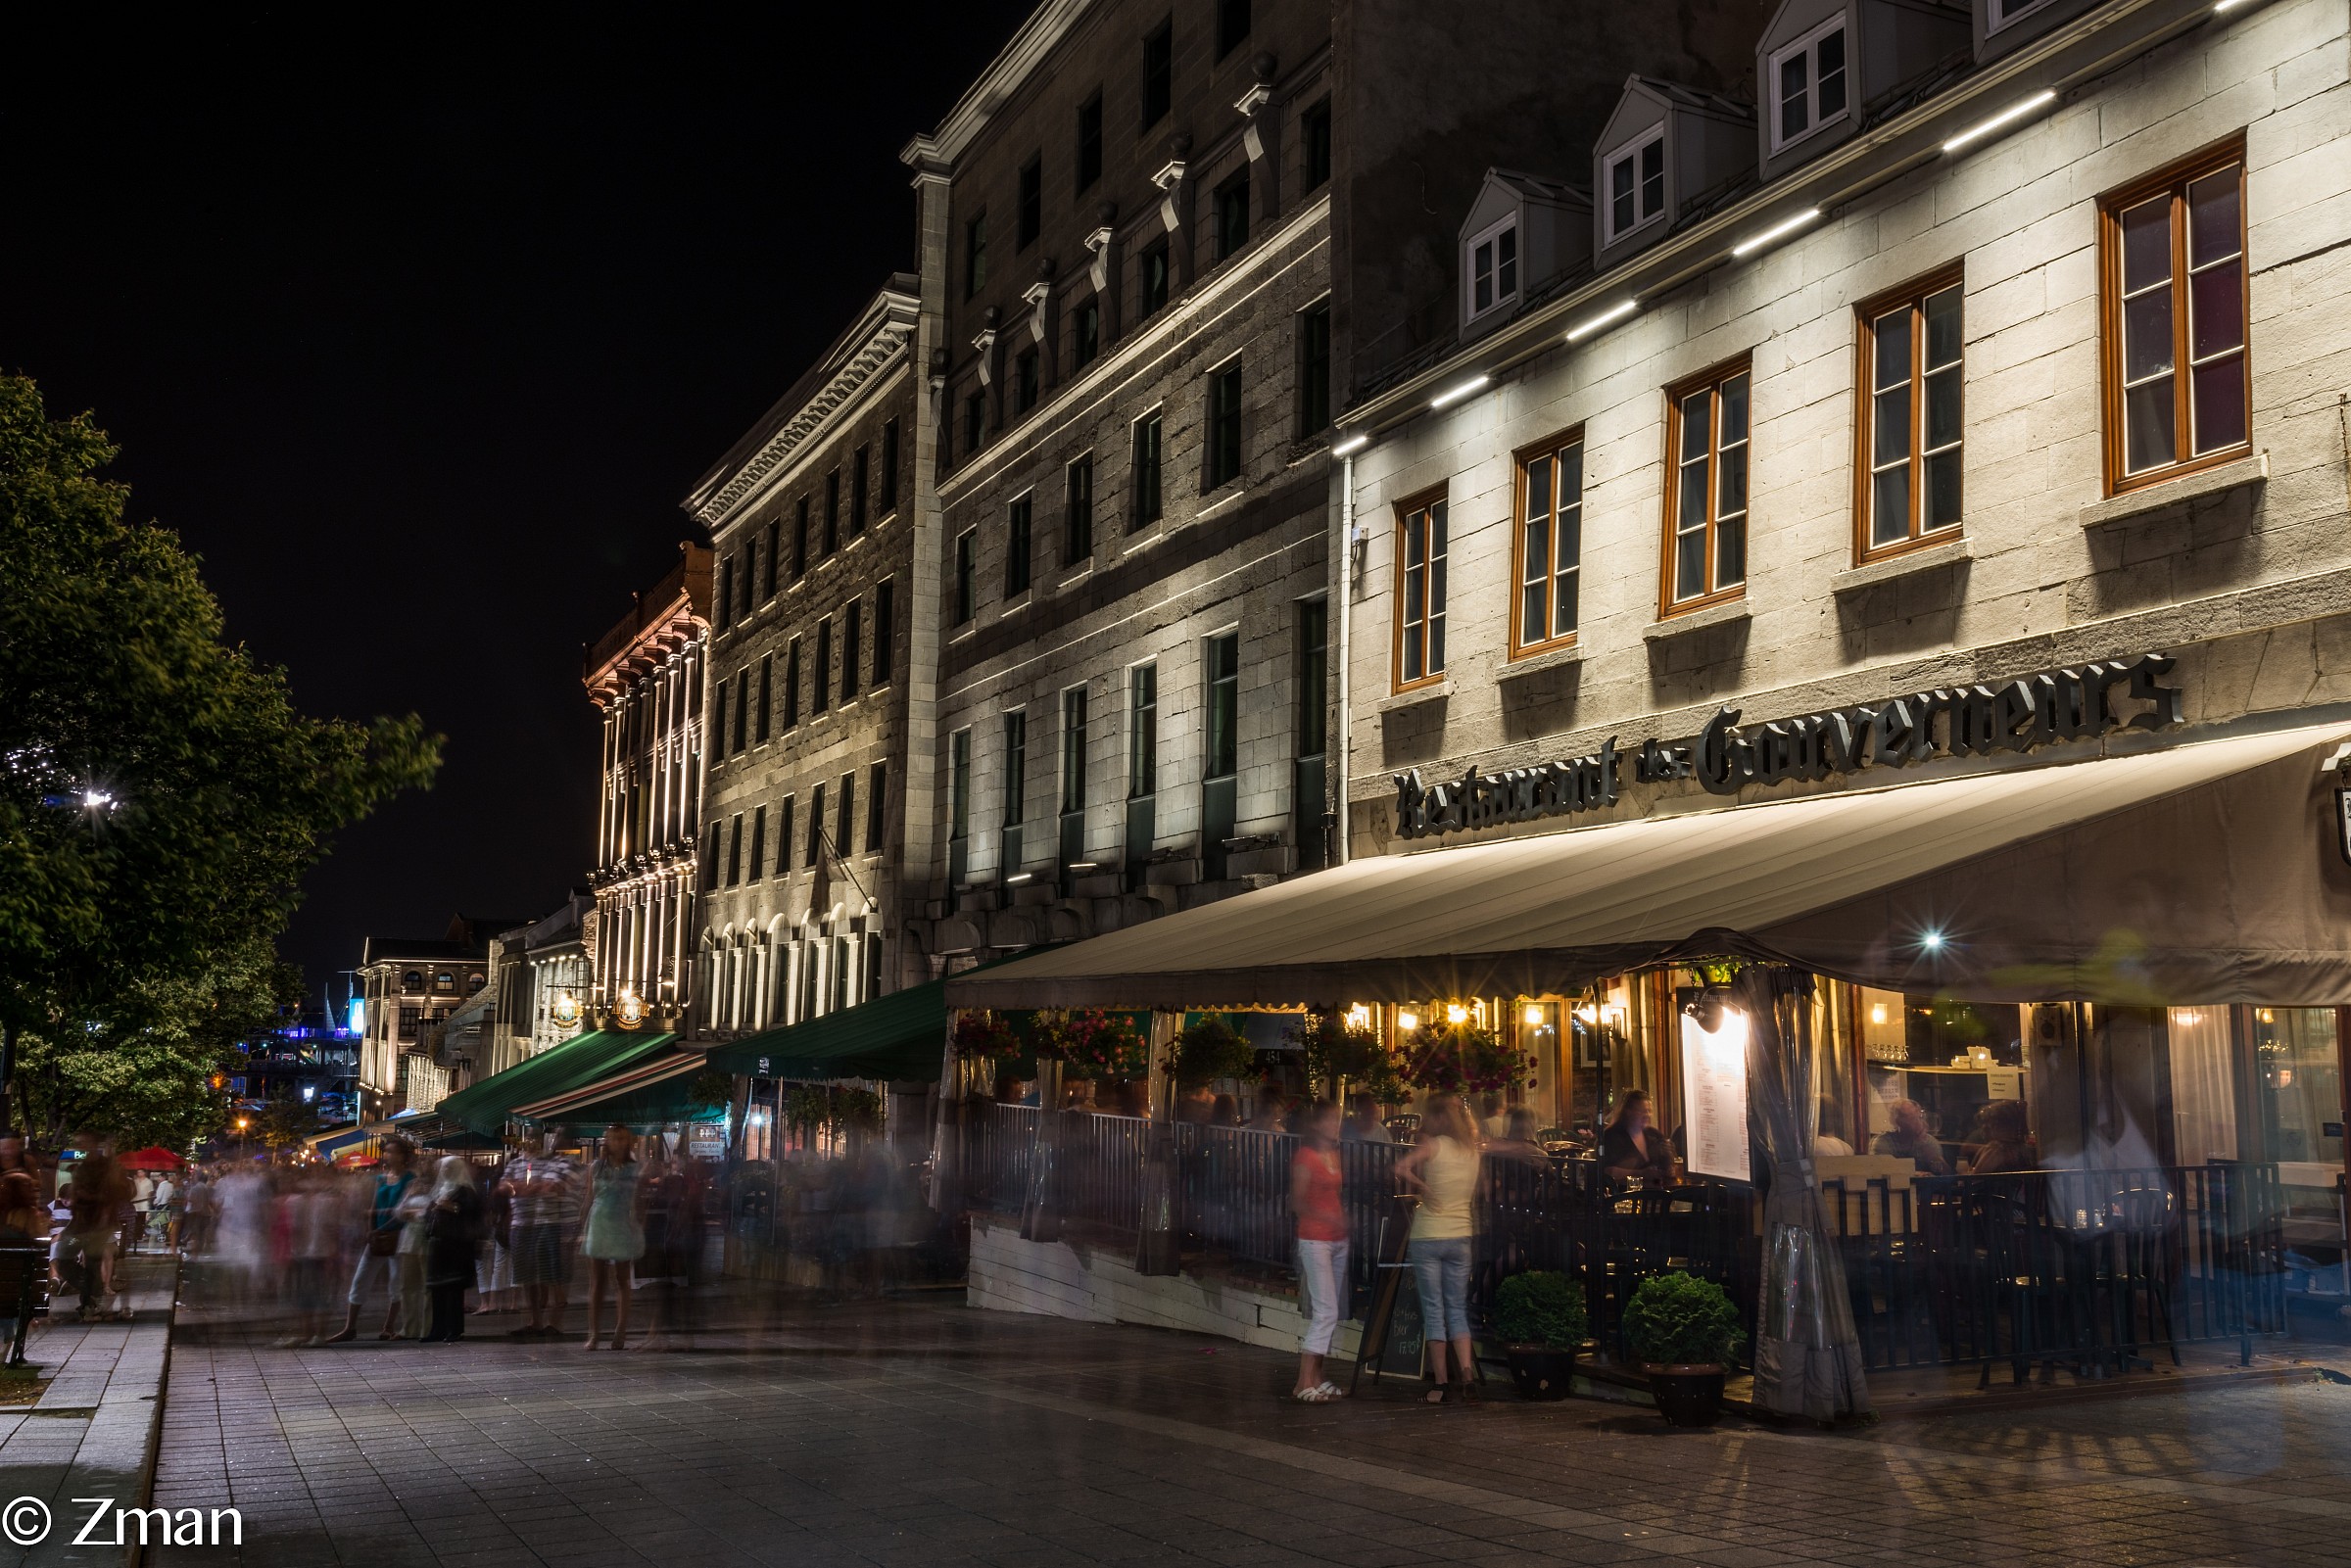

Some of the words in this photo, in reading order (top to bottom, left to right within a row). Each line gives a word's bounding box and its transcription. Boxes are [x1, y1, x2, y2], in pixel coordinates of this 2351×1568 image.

[1394, 735, 1623, 840] Restaurant
[1636, 737, 1692, 783] des
[1696, 653, 2184, 795] Gouverneurs
[1265, 1050, 1280, 1065] 454
